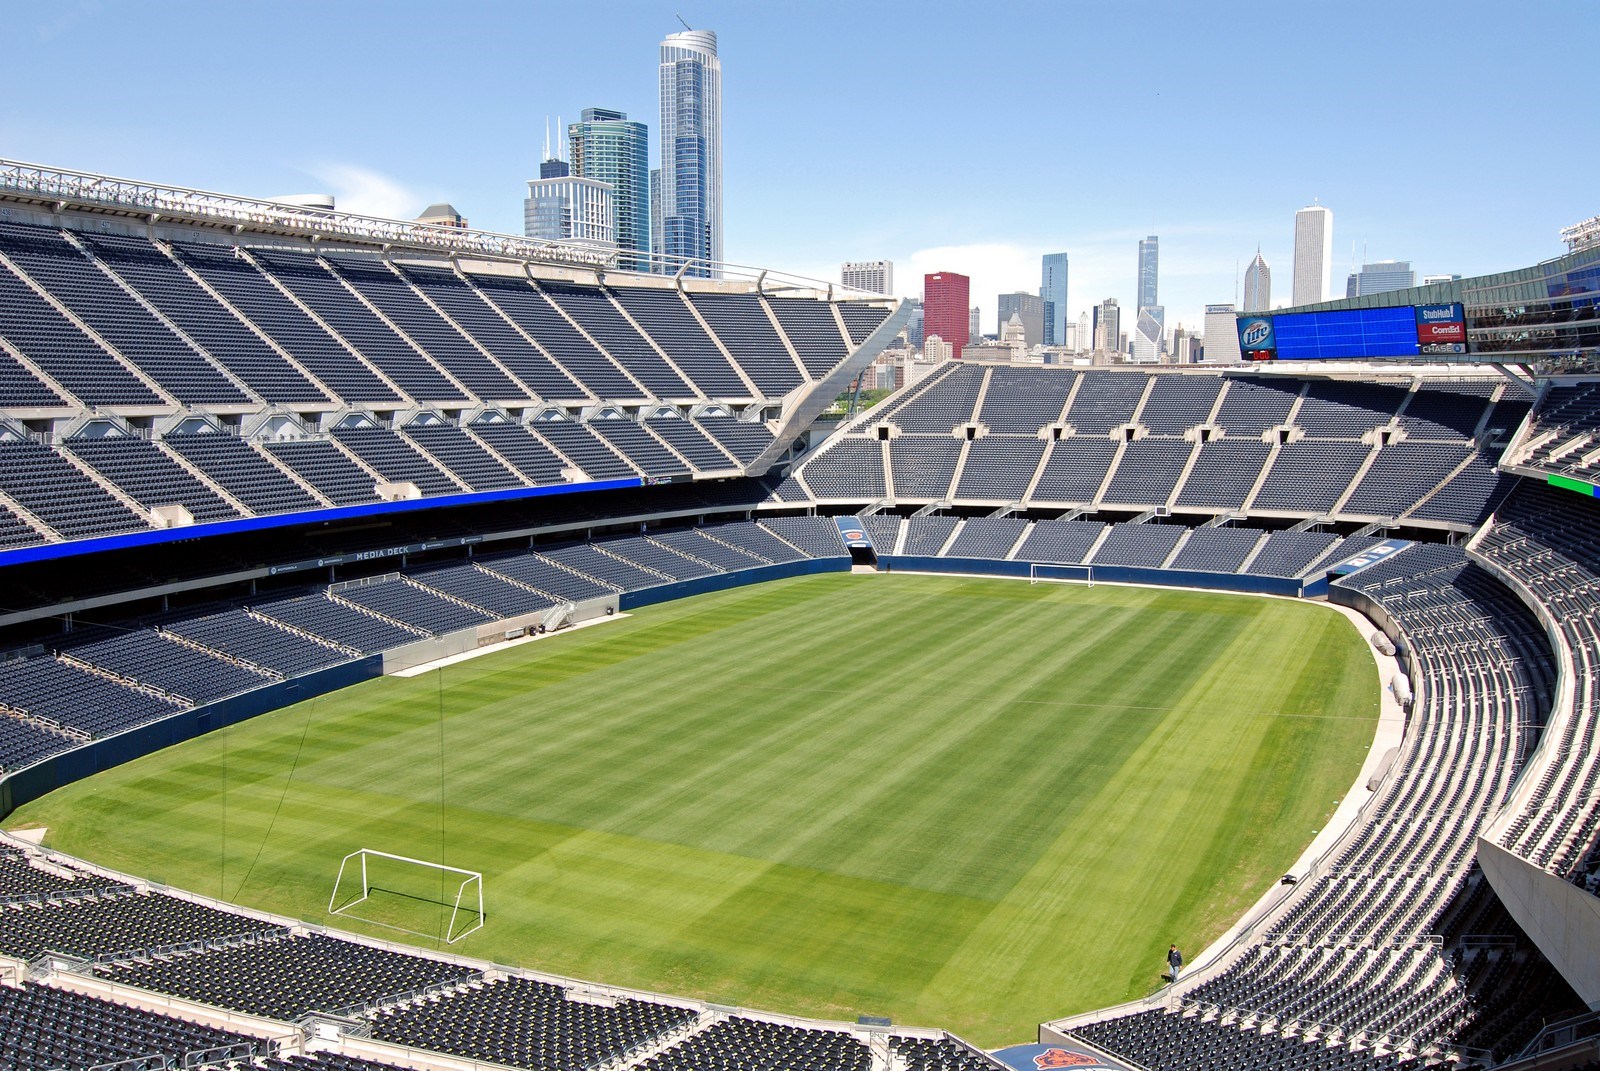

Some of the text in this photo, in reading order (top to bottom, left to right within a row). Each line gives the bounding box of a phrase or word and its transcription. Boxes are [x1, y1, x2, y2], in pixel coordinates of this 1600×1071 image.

[1423, 305, 1454, 319] StubHub!
[1246, 326, 1267, 345] Lite
[1432, 325, 1460, 334] ComEd
[1422, 344, 1452, 353] CHASE
[356, 546, 409, 560] MEDIA DECK
